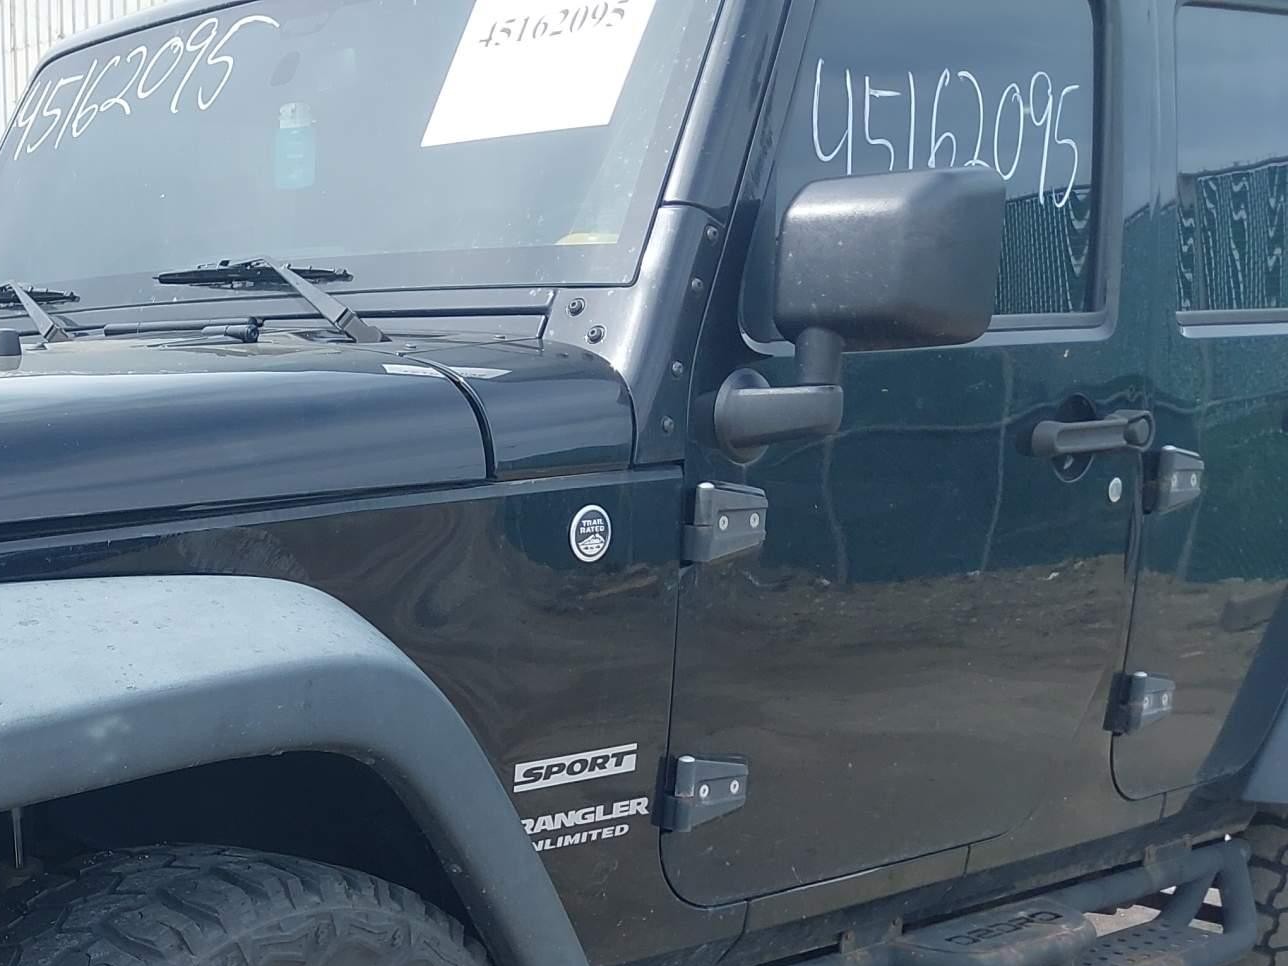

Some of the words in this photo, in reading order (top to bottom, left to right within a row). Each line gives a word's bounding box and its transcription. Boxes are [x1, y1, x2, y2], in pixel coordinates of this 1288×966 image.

[13, 14, 280, 161] 45162095
[812, 57, 1081, 208] 45162095
[579, 525, 605, 534] RATED
[581, 518, 605, 527] TRAIL
[514, 749, 638, 786] SPORT
[521, 797, 650, 835] RANGLER
[532, 824, 630, 852] NLIMITED
